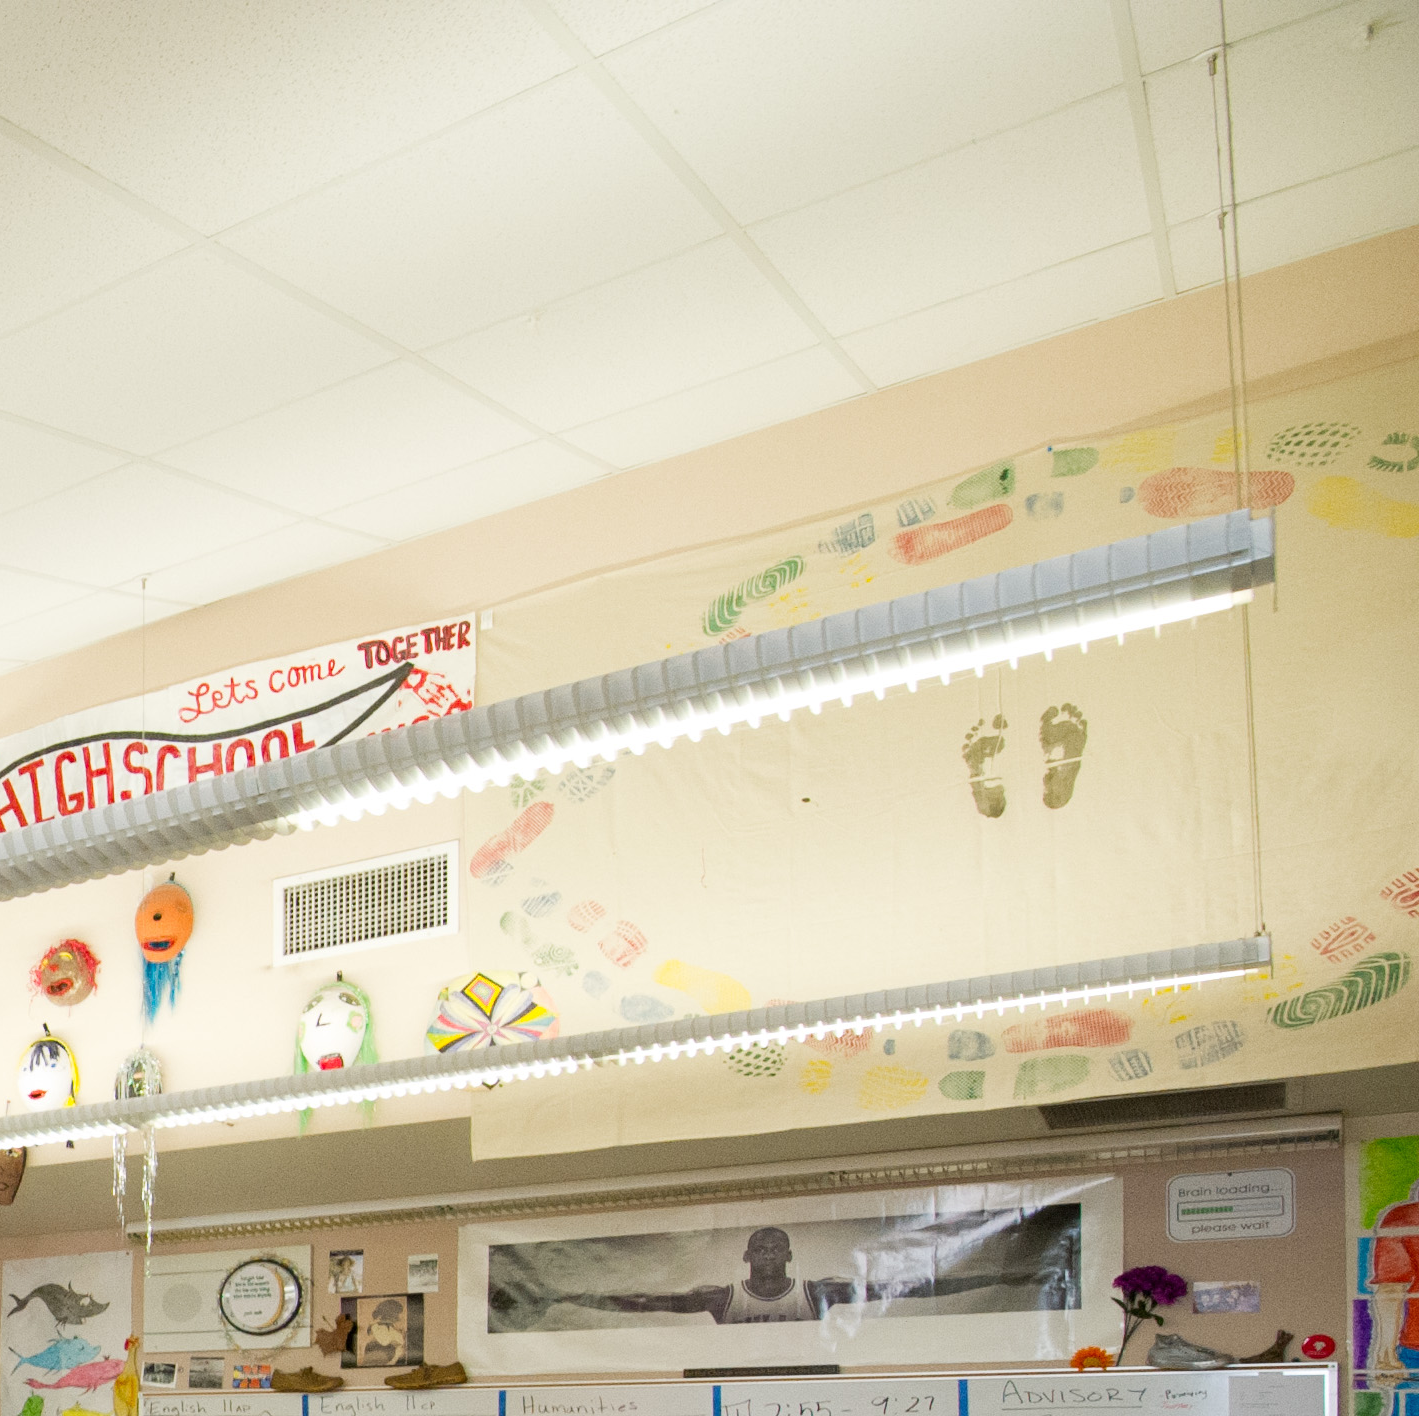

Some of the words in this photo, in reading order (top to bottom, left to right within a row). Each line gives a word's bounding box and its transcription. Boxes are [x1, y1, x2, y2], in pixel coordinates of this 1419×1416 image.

[179, 675, 259, 724] Lets
[268, 657, 345, 695] come
[1178, 1187, 1212, 1198] Brain
[1191, 1222, 1237, 1235] please
[1240, 1221, 1270, 1231] wait
[1002, 1379, 1147, 1405] ADVISORY
[521, 1395, 640, 1416] Humanities
[870, 1396, 936, 1416] 9:27
